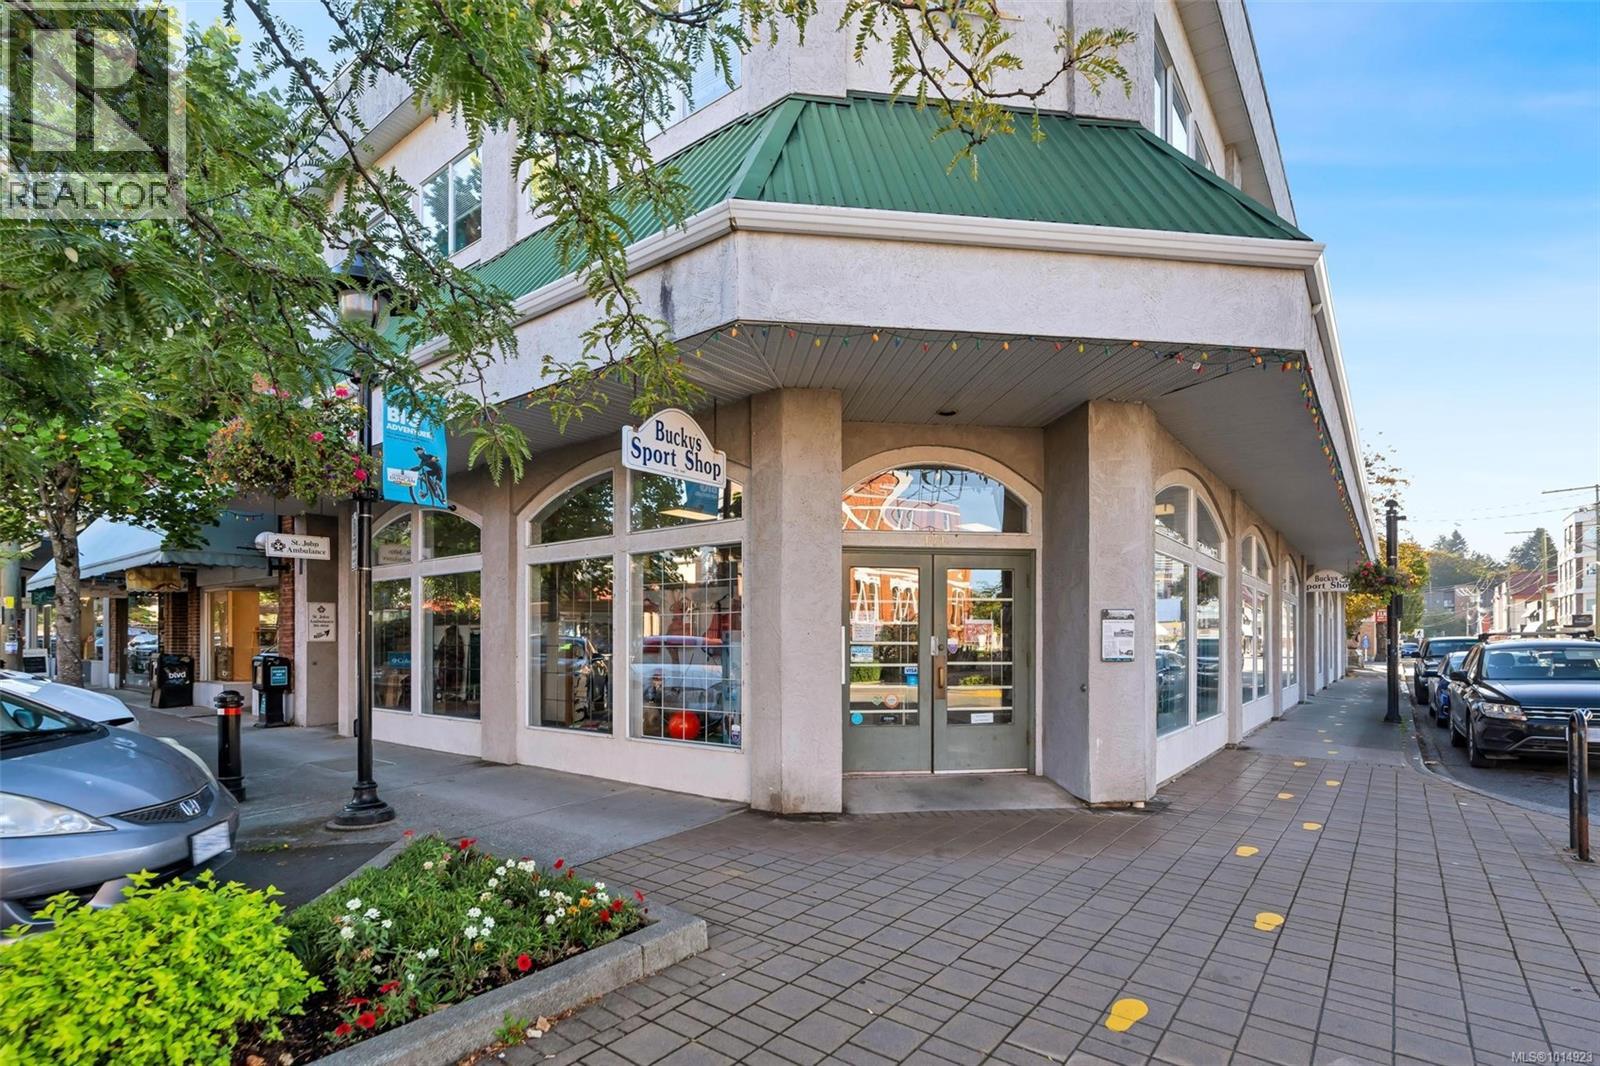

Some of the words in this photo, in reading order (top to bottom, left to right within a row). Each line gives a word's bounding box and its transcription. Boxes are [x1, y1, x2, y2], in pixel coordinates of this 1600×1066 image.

[630, 436, 677, 467] Sport
[684, 449, 721, 481] Shop
[302, 540, 320, 548] John
[287, 547, 327, 555] Ambulance
[1305, 583, 1326, 591] port
[1330, 581, 1350, 590] Sho
[168, 671, 186, 679] blvd
